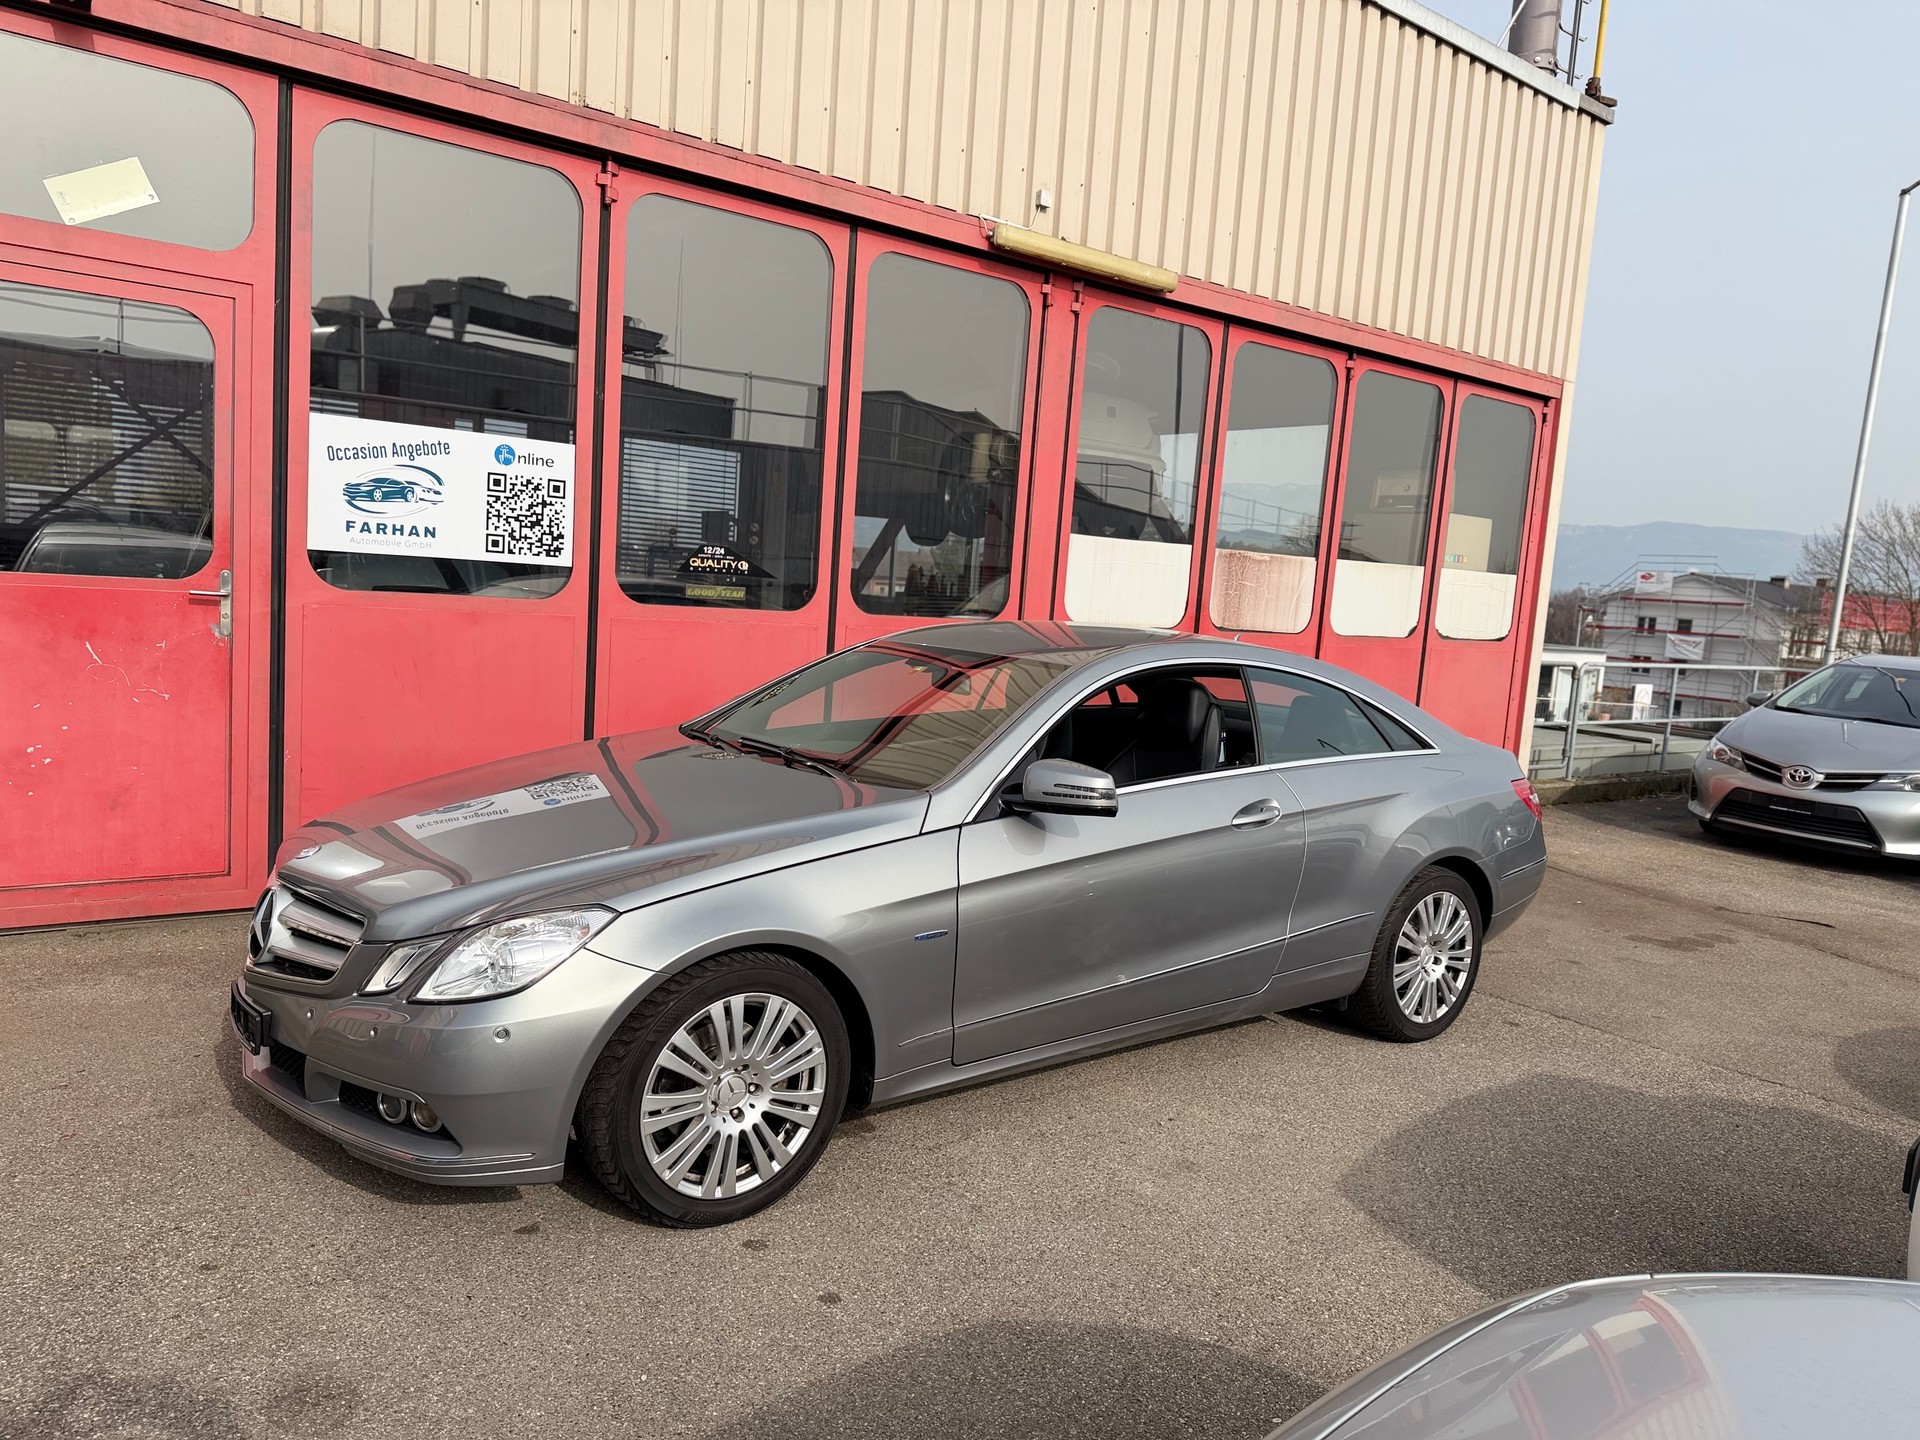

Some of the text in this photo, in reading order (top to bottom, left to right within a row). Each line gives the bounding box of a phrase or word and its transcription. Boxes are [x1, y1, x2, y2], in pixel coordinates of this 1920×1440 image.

[326, 440, 451, 461] Occasion Angebote
[345, 520, 437, 538] FARHAN
[349, 536, 432, 549] Automobile GmbH
[703, 546, 725, 555] 12/24
[687, 586, 745, 598] GOODYEAR
